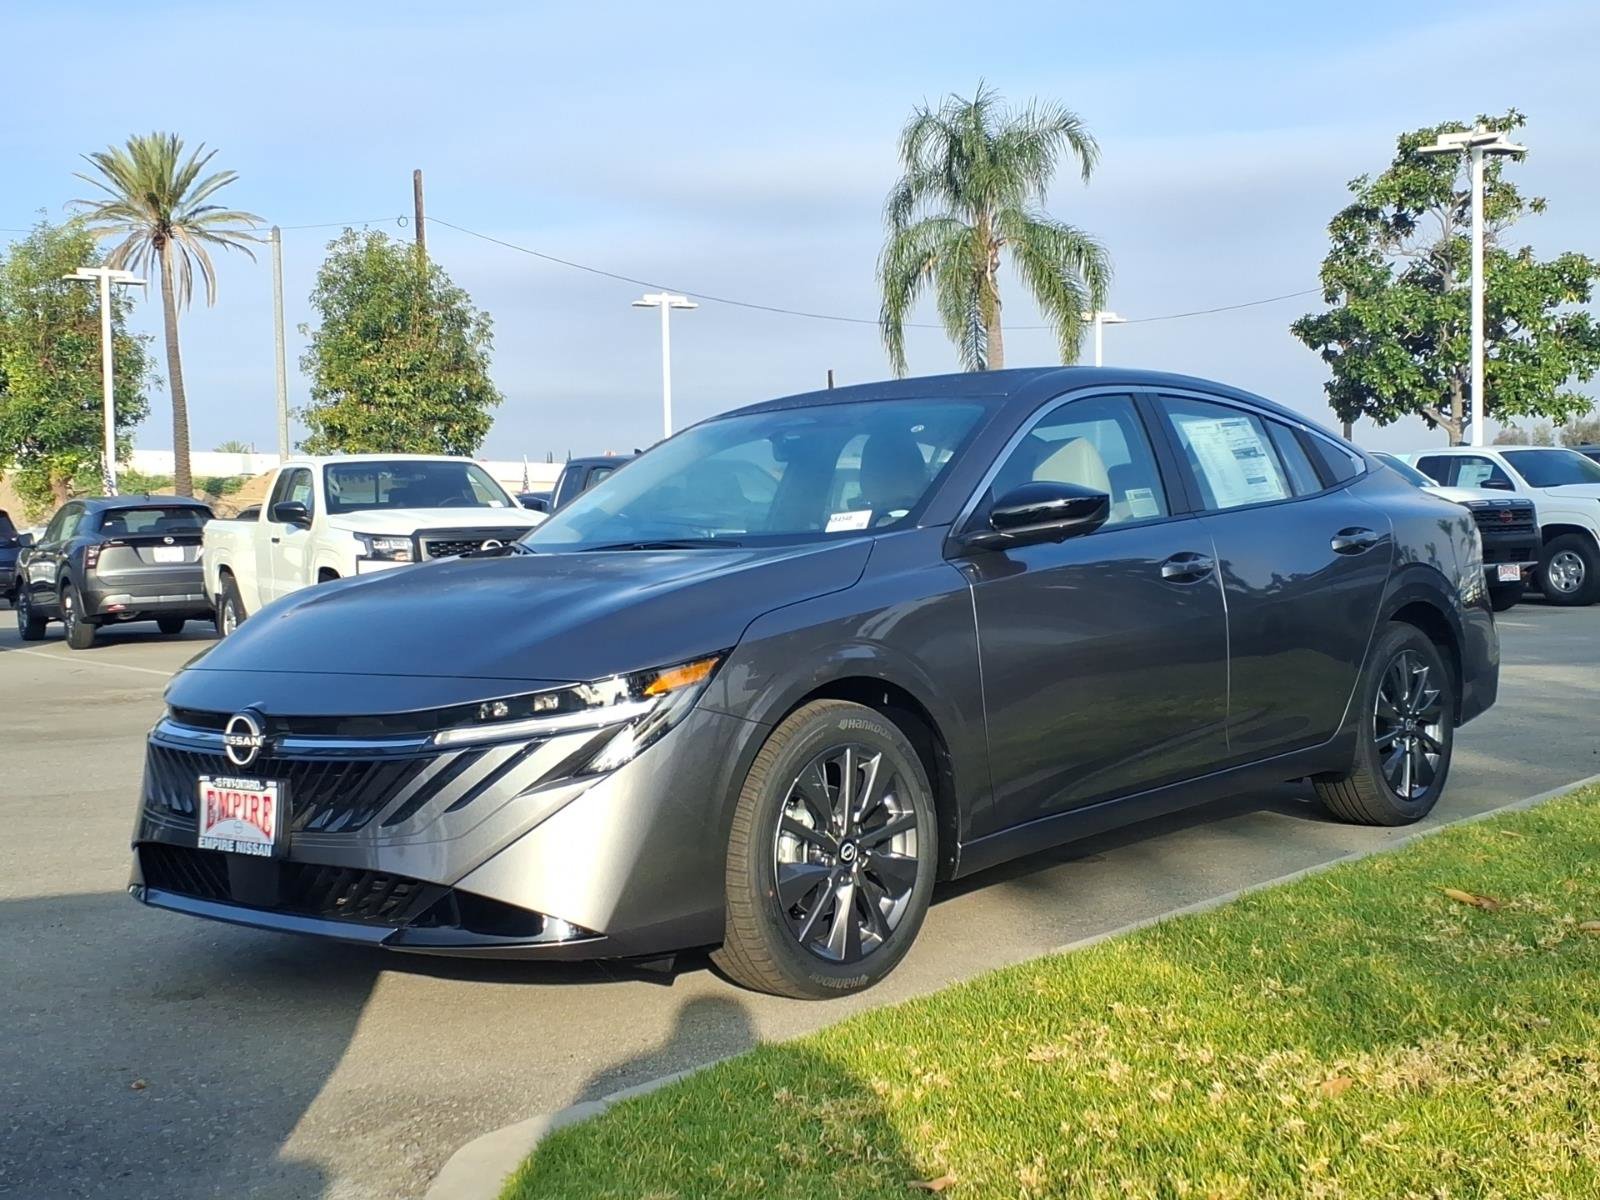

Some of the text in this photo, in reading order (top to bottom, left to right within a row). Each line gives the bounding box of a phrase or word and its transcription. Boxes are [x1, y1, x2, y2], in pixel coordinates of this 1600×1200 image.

[206, 790, 272, 841] EMPIRE
[198, 837, 272, 857] EMPIRE NISSAN
